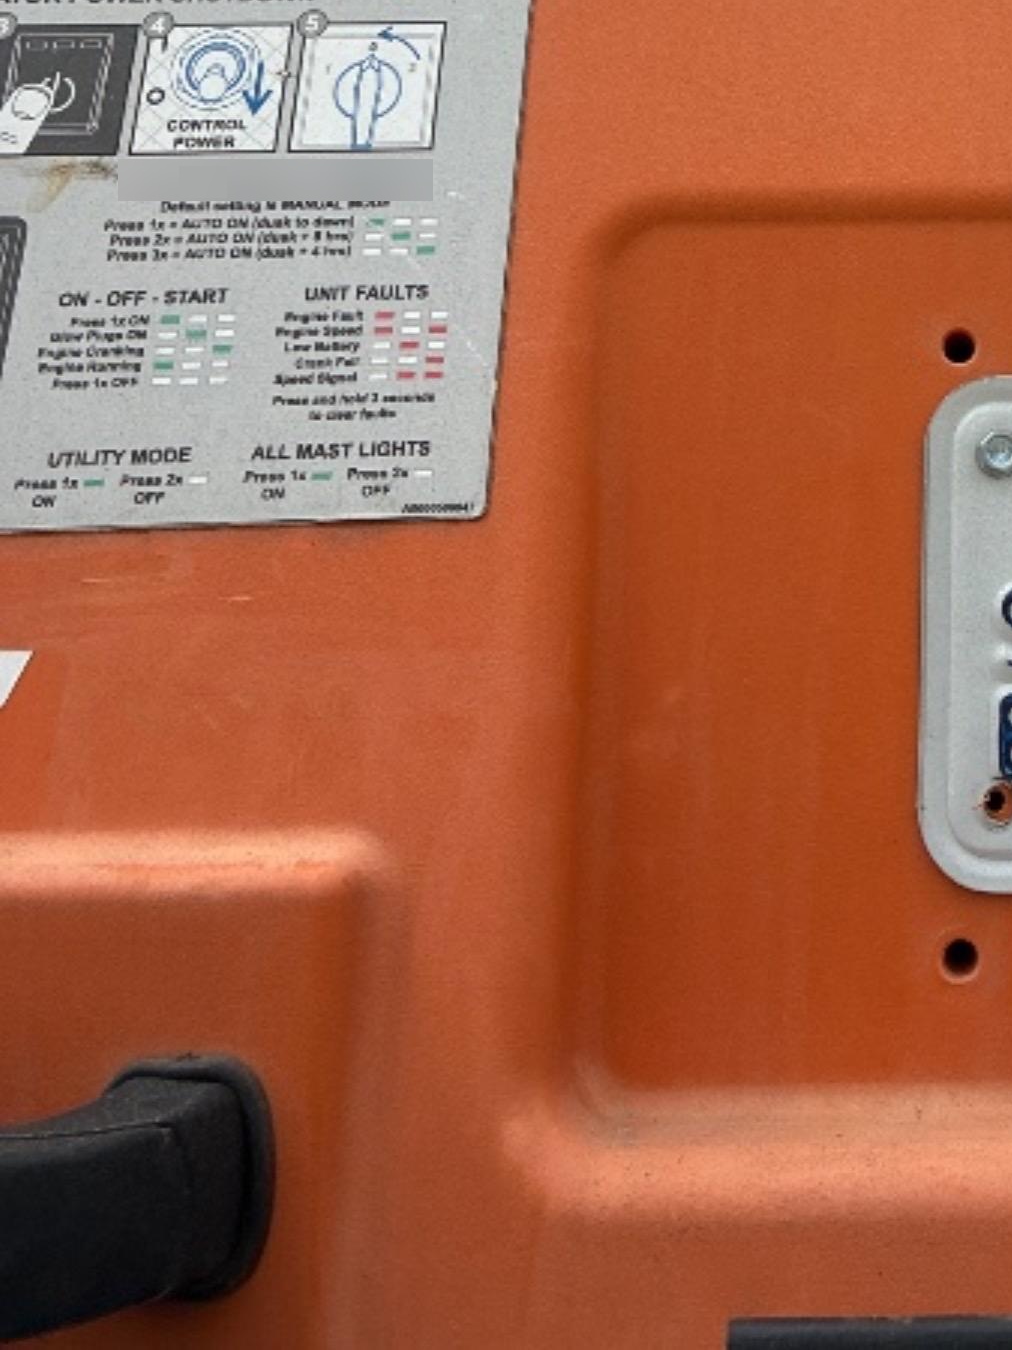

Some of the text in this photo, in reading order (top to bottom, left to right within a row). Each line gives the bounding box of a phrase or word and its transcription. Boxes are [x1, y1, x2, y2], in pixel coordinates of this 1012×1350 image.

[151, 18, 164, 34] 4
[306, 15, 319, 31] 5
[167, 118, 247, 132] CONTROL
[173, 136, 236, 148] POWER
[59, 290, 89, 307] ON
[107, 290, 147, 307] OFF
[164, 288, 228, 305] START
[305, 284, 429, 301] UNIT FAULTS
[48, 447, 192, 469] UTILITY MODE
[252, 440, 431, 460] ALL MAST LIGHTS
